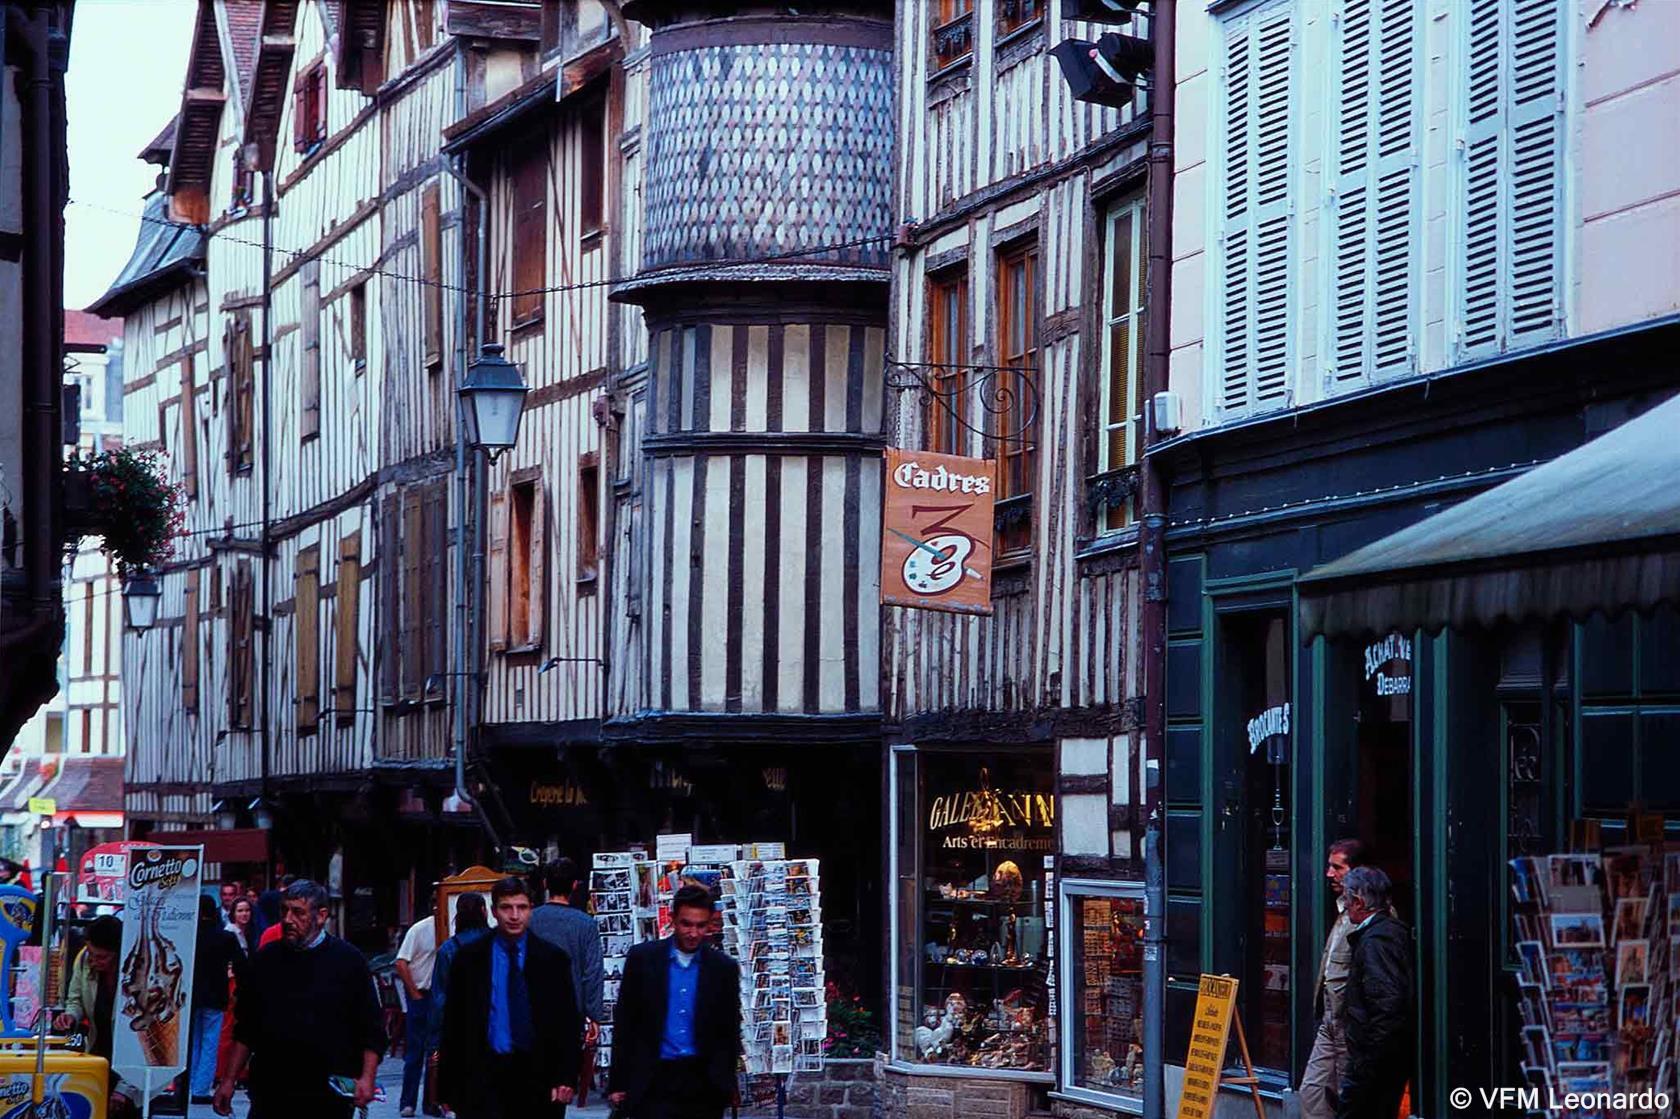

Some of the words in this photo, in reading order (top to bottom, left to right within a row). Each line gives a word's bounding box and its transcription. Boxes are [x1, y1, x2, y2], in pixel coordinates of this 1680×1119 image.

[894, 462, 990, 494] Cadres
[942, 836, 967, 848] Arts
[99, 855, 113, 867] 10
[131, 859, 181, 887] Cornetto
